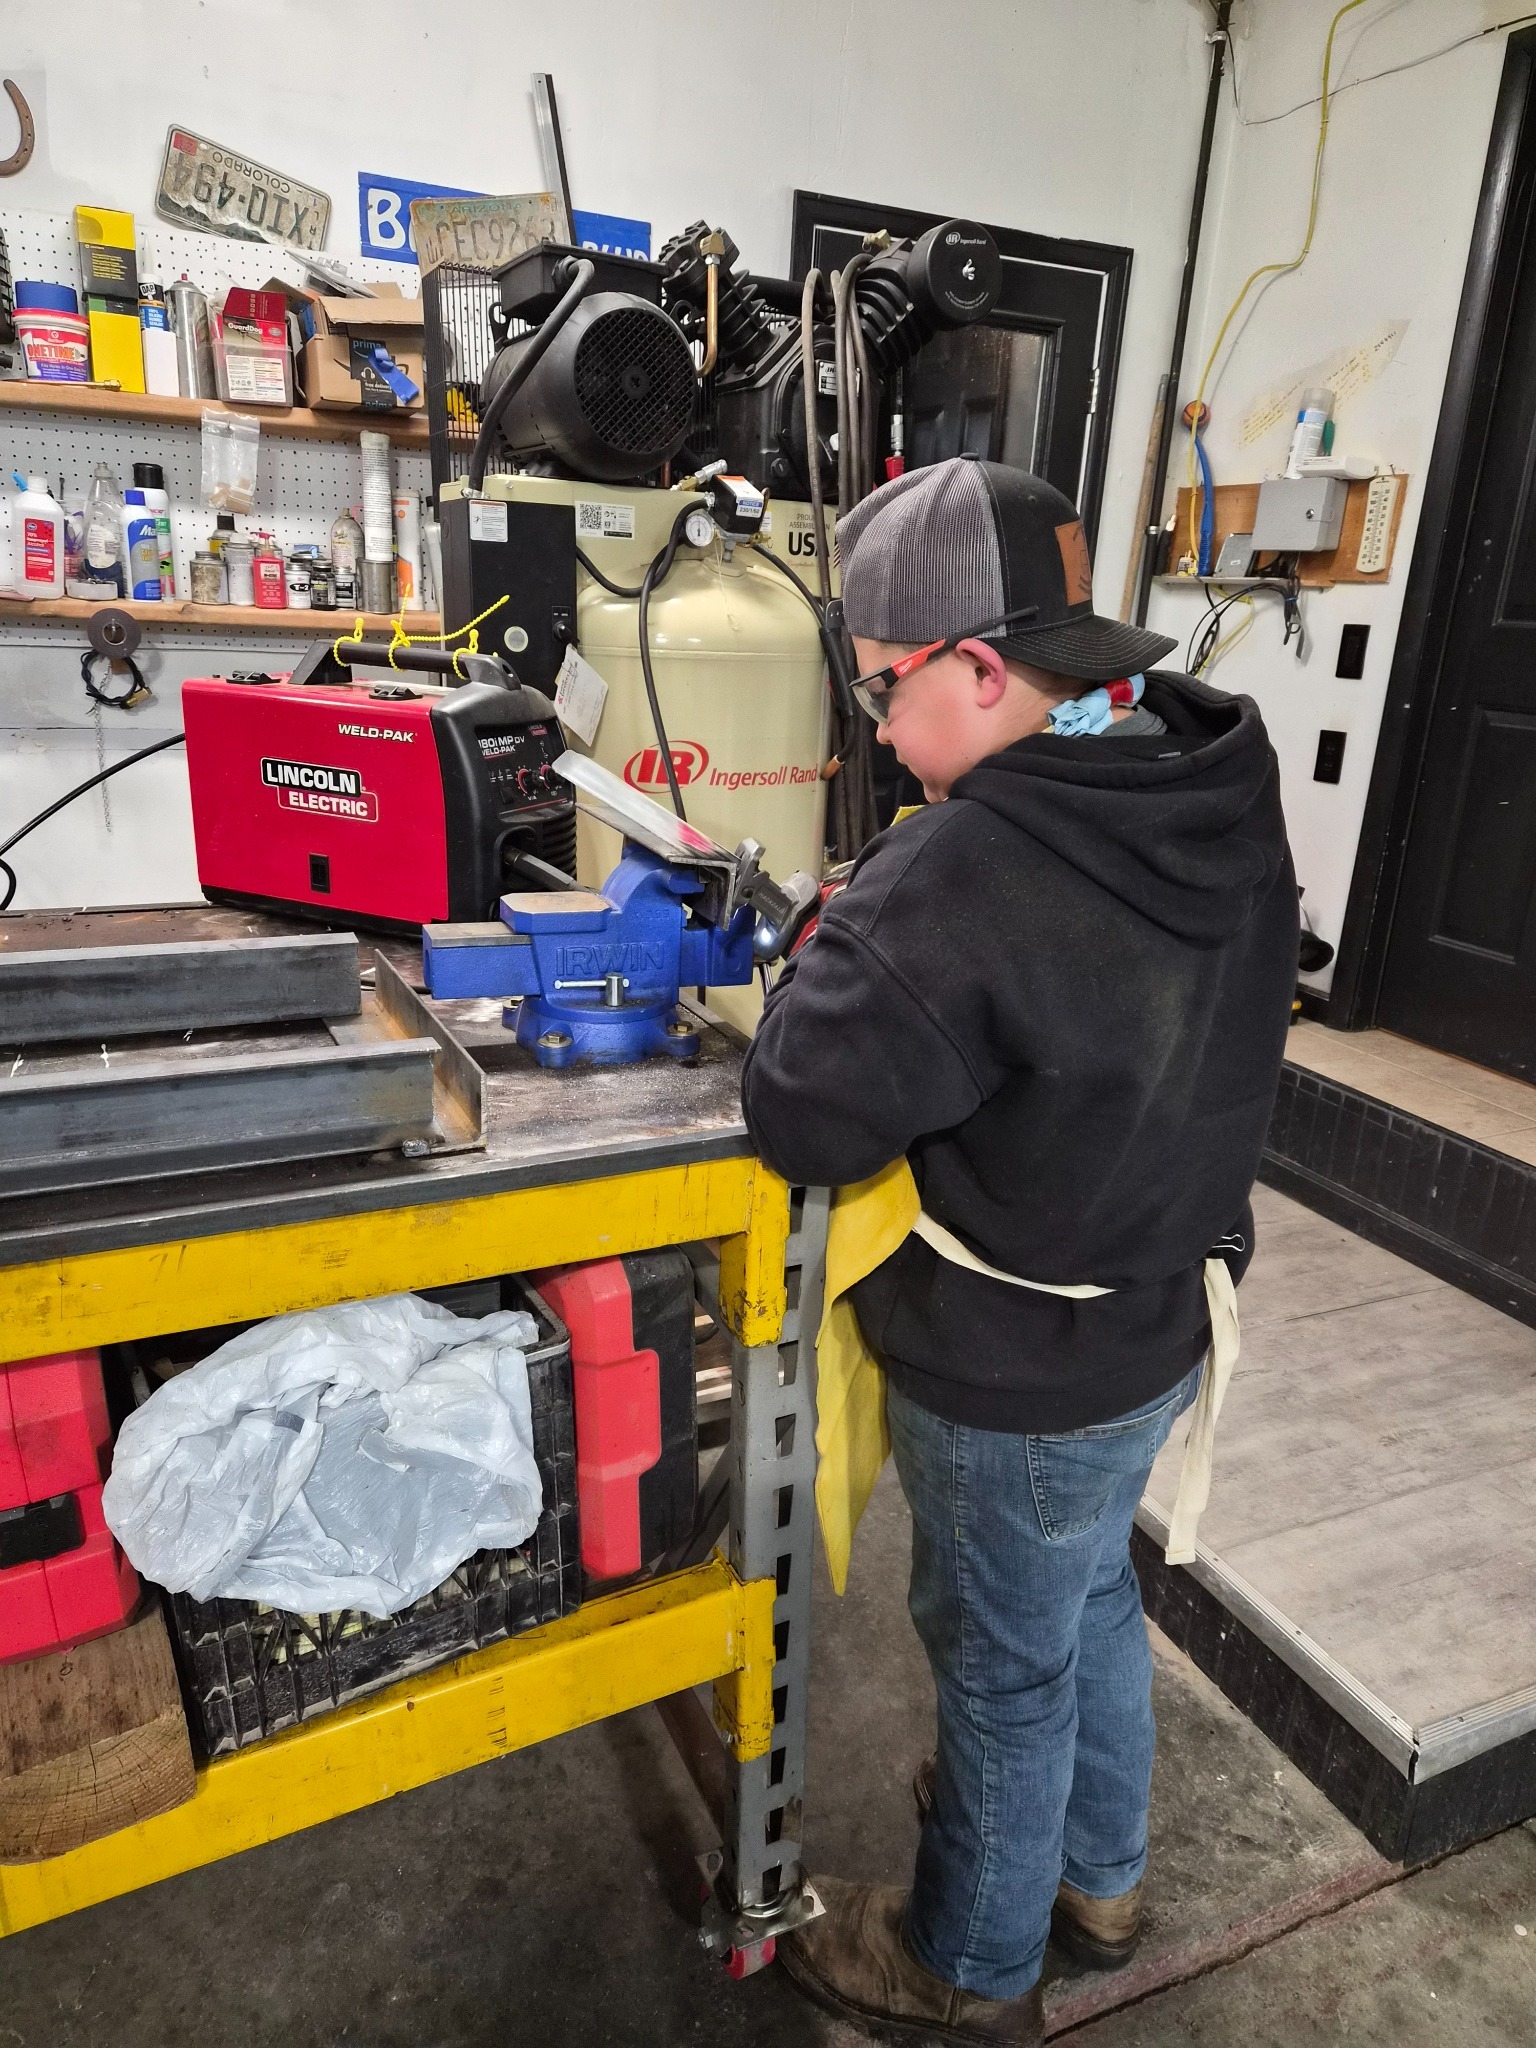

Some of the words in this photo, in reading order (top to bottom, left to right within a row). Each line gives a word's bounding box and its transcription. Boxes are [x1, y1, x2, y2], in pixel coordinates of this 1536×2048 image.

[212, 152, 291, 194] COLORADO
[452, 201, 522, 214] ARIZONA
[142, 284, 155, 294] DAP
[228, 322, 263, 334] GuardDog
[27, 344, 75, 360] ONETIME
[789, 521, 815, 530] ASSEMBL
[789, 532, 830, 557] US
[338, 724, 414, 743] WELD-PAK
[498, 735, 514, 746] MP
[514, 735, 525, 744] DV
[266, 762, 357, 794] LINCOLN
[709, 766, 788, 791] Ingersoll
[789, 763, 819, 785] Rand
[289, 791, 369, 818] ELECTRIC
[556, 941, 664, 977] IRWIN
